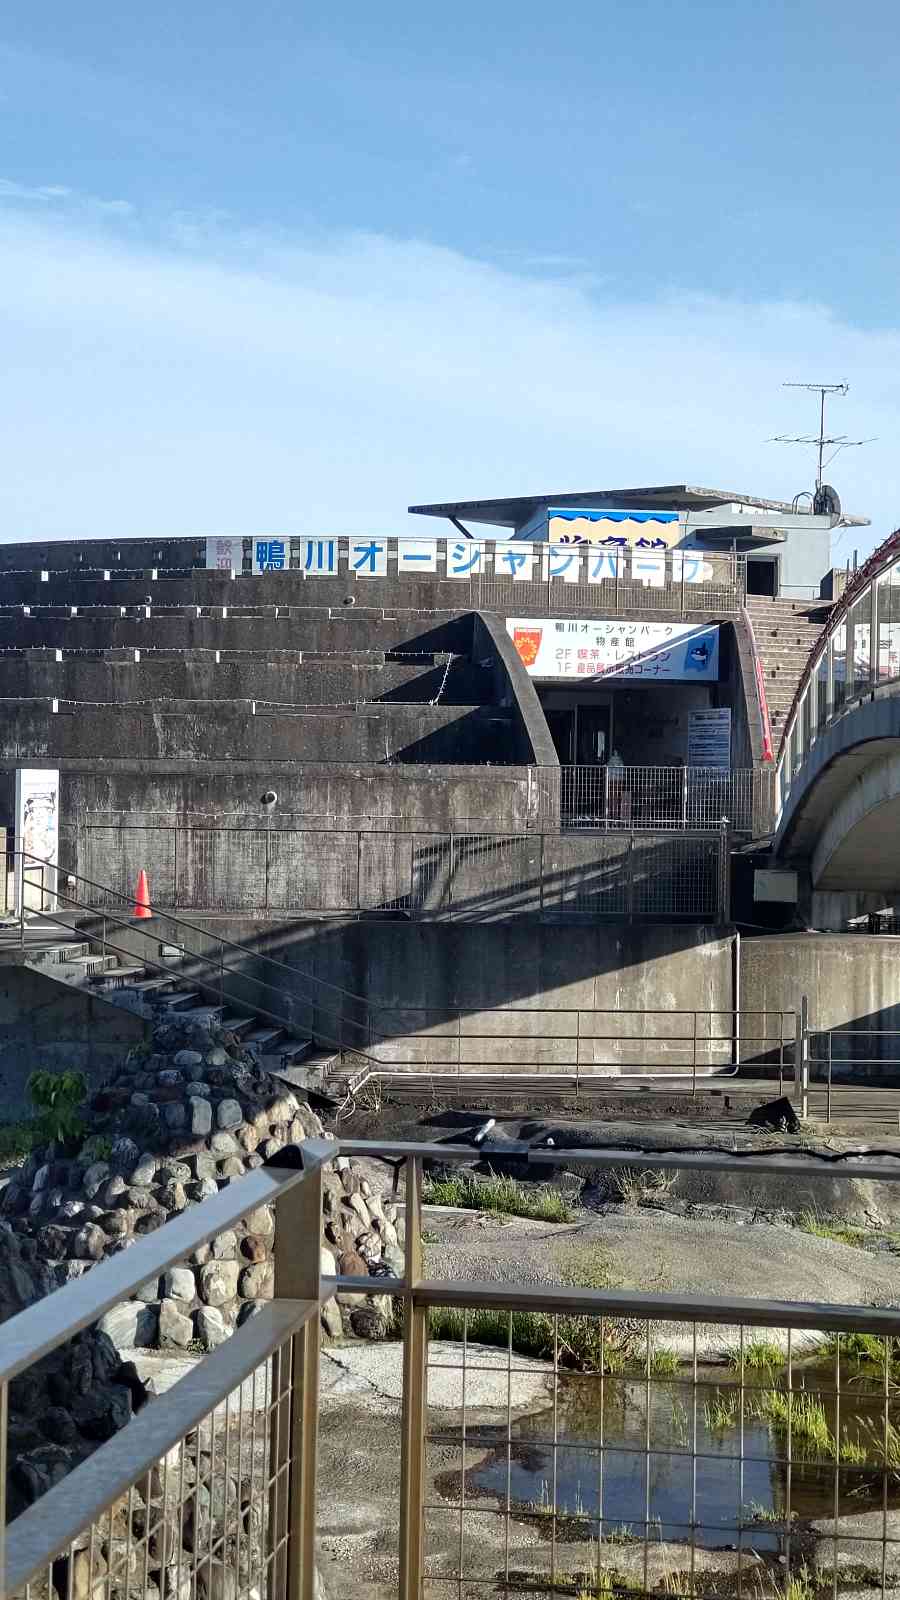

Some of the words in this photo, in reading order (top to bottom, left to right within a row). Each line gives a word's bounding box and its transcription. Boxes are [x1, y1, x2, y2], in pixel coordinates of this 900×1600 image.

[555, 622, 673, 636] 鴨川オーシャンパーク
[595, 636, 635, 647] 物産館
[555, 648, 572, 660] 2F
[557, 662, 572, 673] 1F
